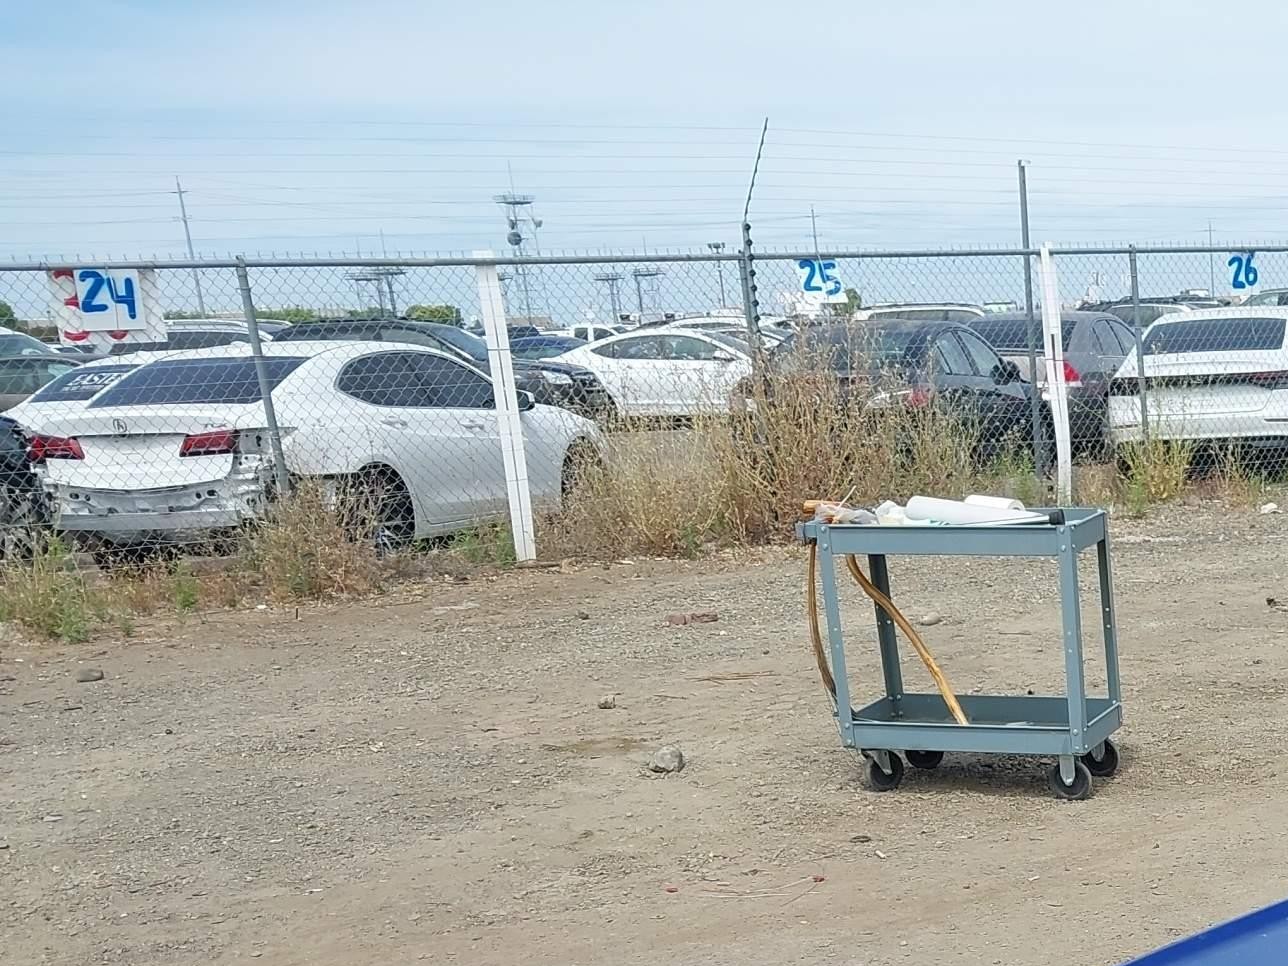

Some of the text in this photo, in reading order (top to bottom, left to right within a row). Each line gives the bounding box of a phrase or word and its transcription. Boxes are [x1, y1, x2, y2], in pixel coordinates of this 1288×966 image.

[799, 260, 841, 295] 25
[1228, 254, 1258, 289] 26
[79, 270, 137, 320] 24
